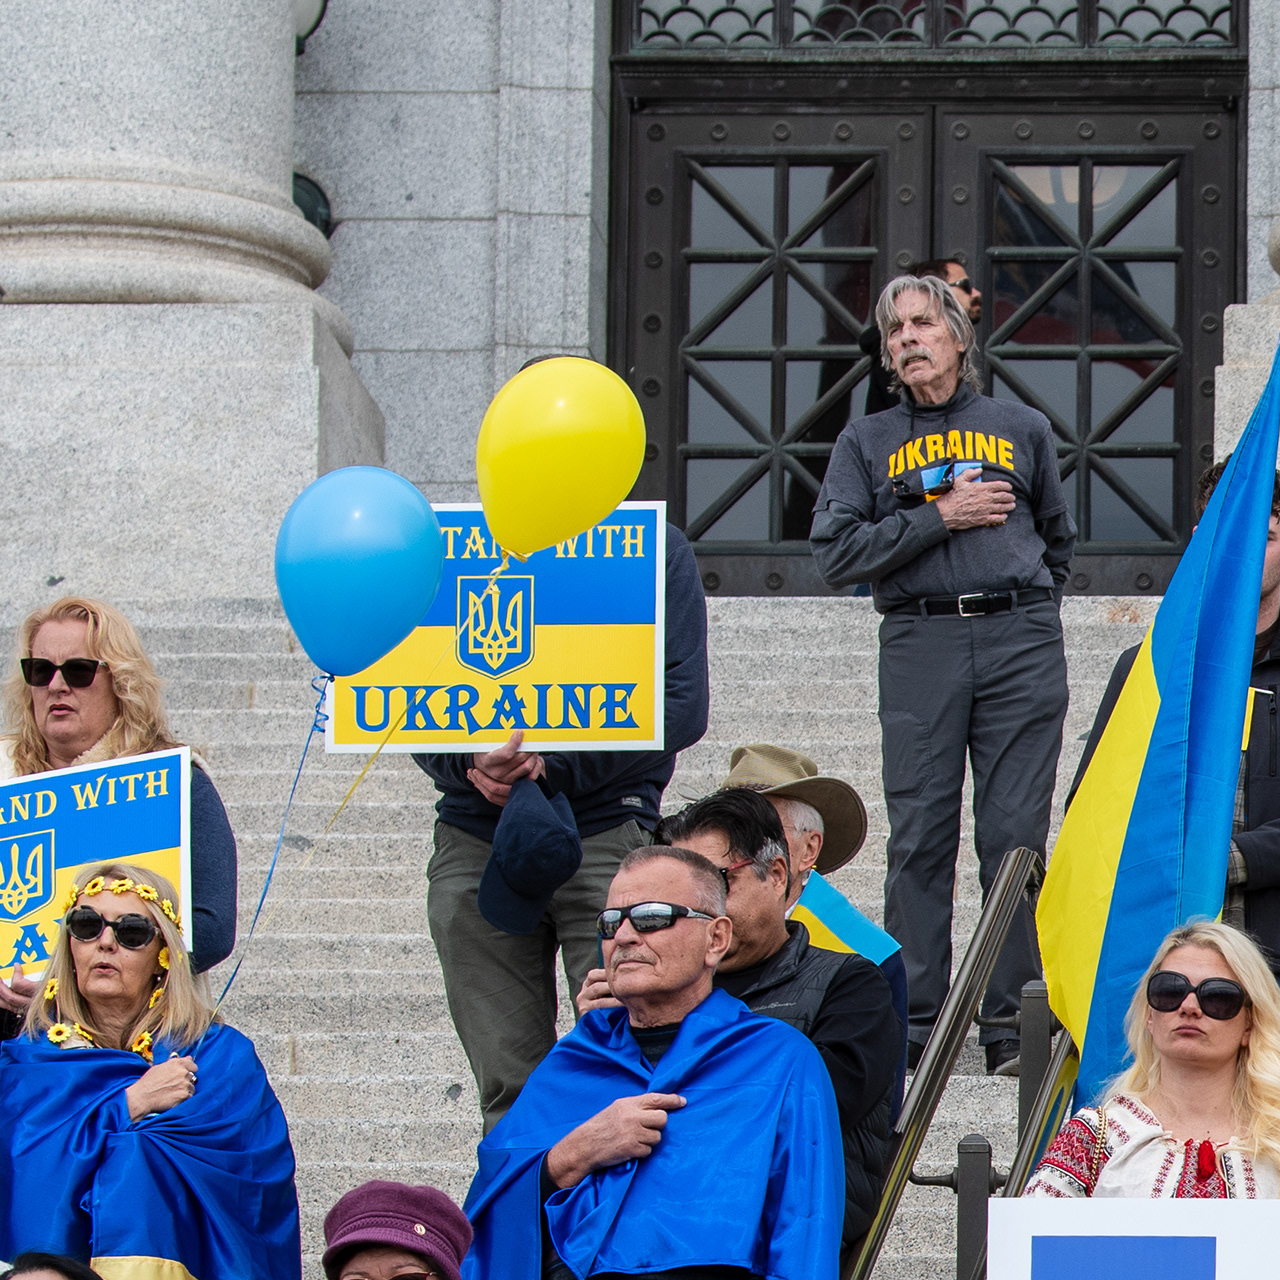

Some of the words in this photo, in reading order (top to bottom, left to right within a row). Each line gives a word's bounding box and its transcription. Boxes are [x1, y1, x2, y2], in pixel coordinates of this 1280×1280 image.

[887, 429, 1015, 478] UKRAINE
[554, 525, 646, 558] WITH
[350, 682, 640, 736] UKRAINE
[71, 768, 169, 811] WITH
